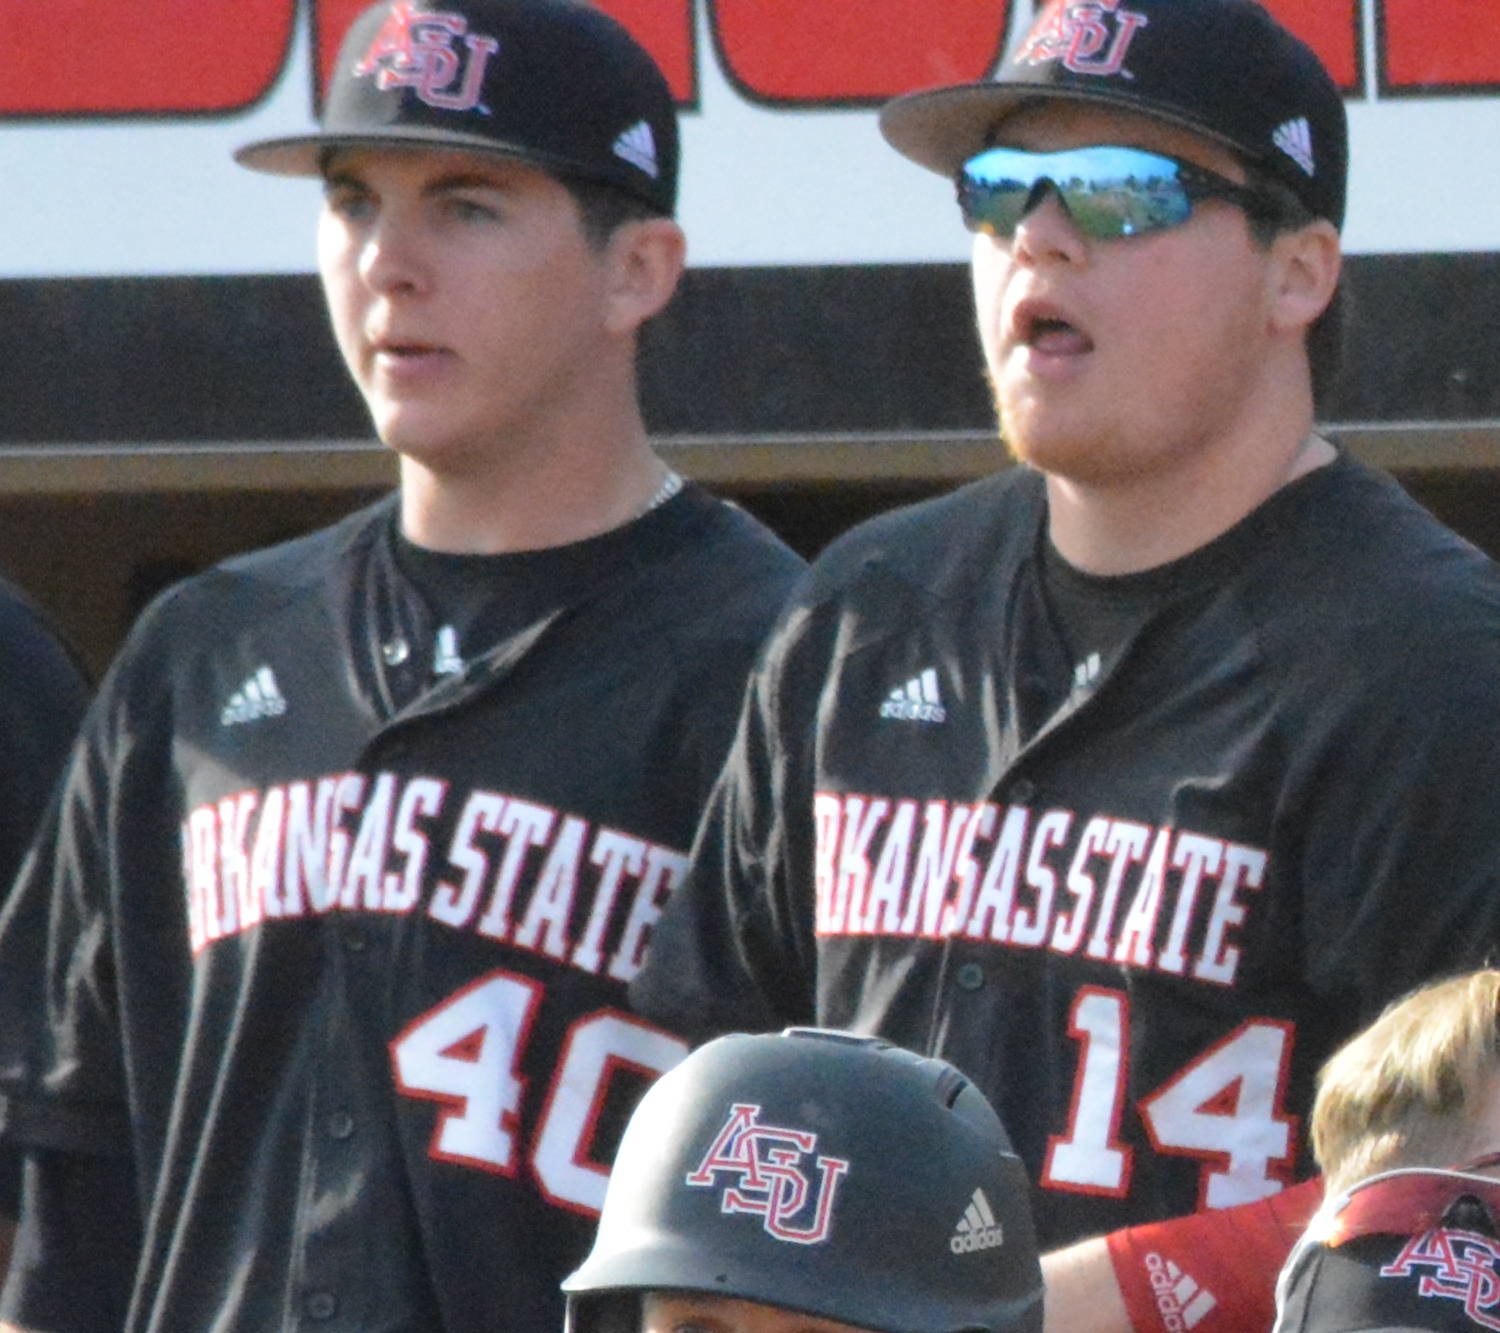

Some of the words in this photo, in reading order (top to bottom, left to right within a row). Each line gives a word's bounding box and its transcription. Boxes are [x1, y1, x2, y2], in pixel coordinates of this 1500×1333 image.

[182, 772, 448, 958] RKANSAS
[427, 789, 690, 982] STATE
[814, 792, 1074, 948] RKANSAS
[1050, 814, 1270, 986] STATE
[687, 1103, 848, 1245] ASU
[1039, 984, 1297, 1212] 14
